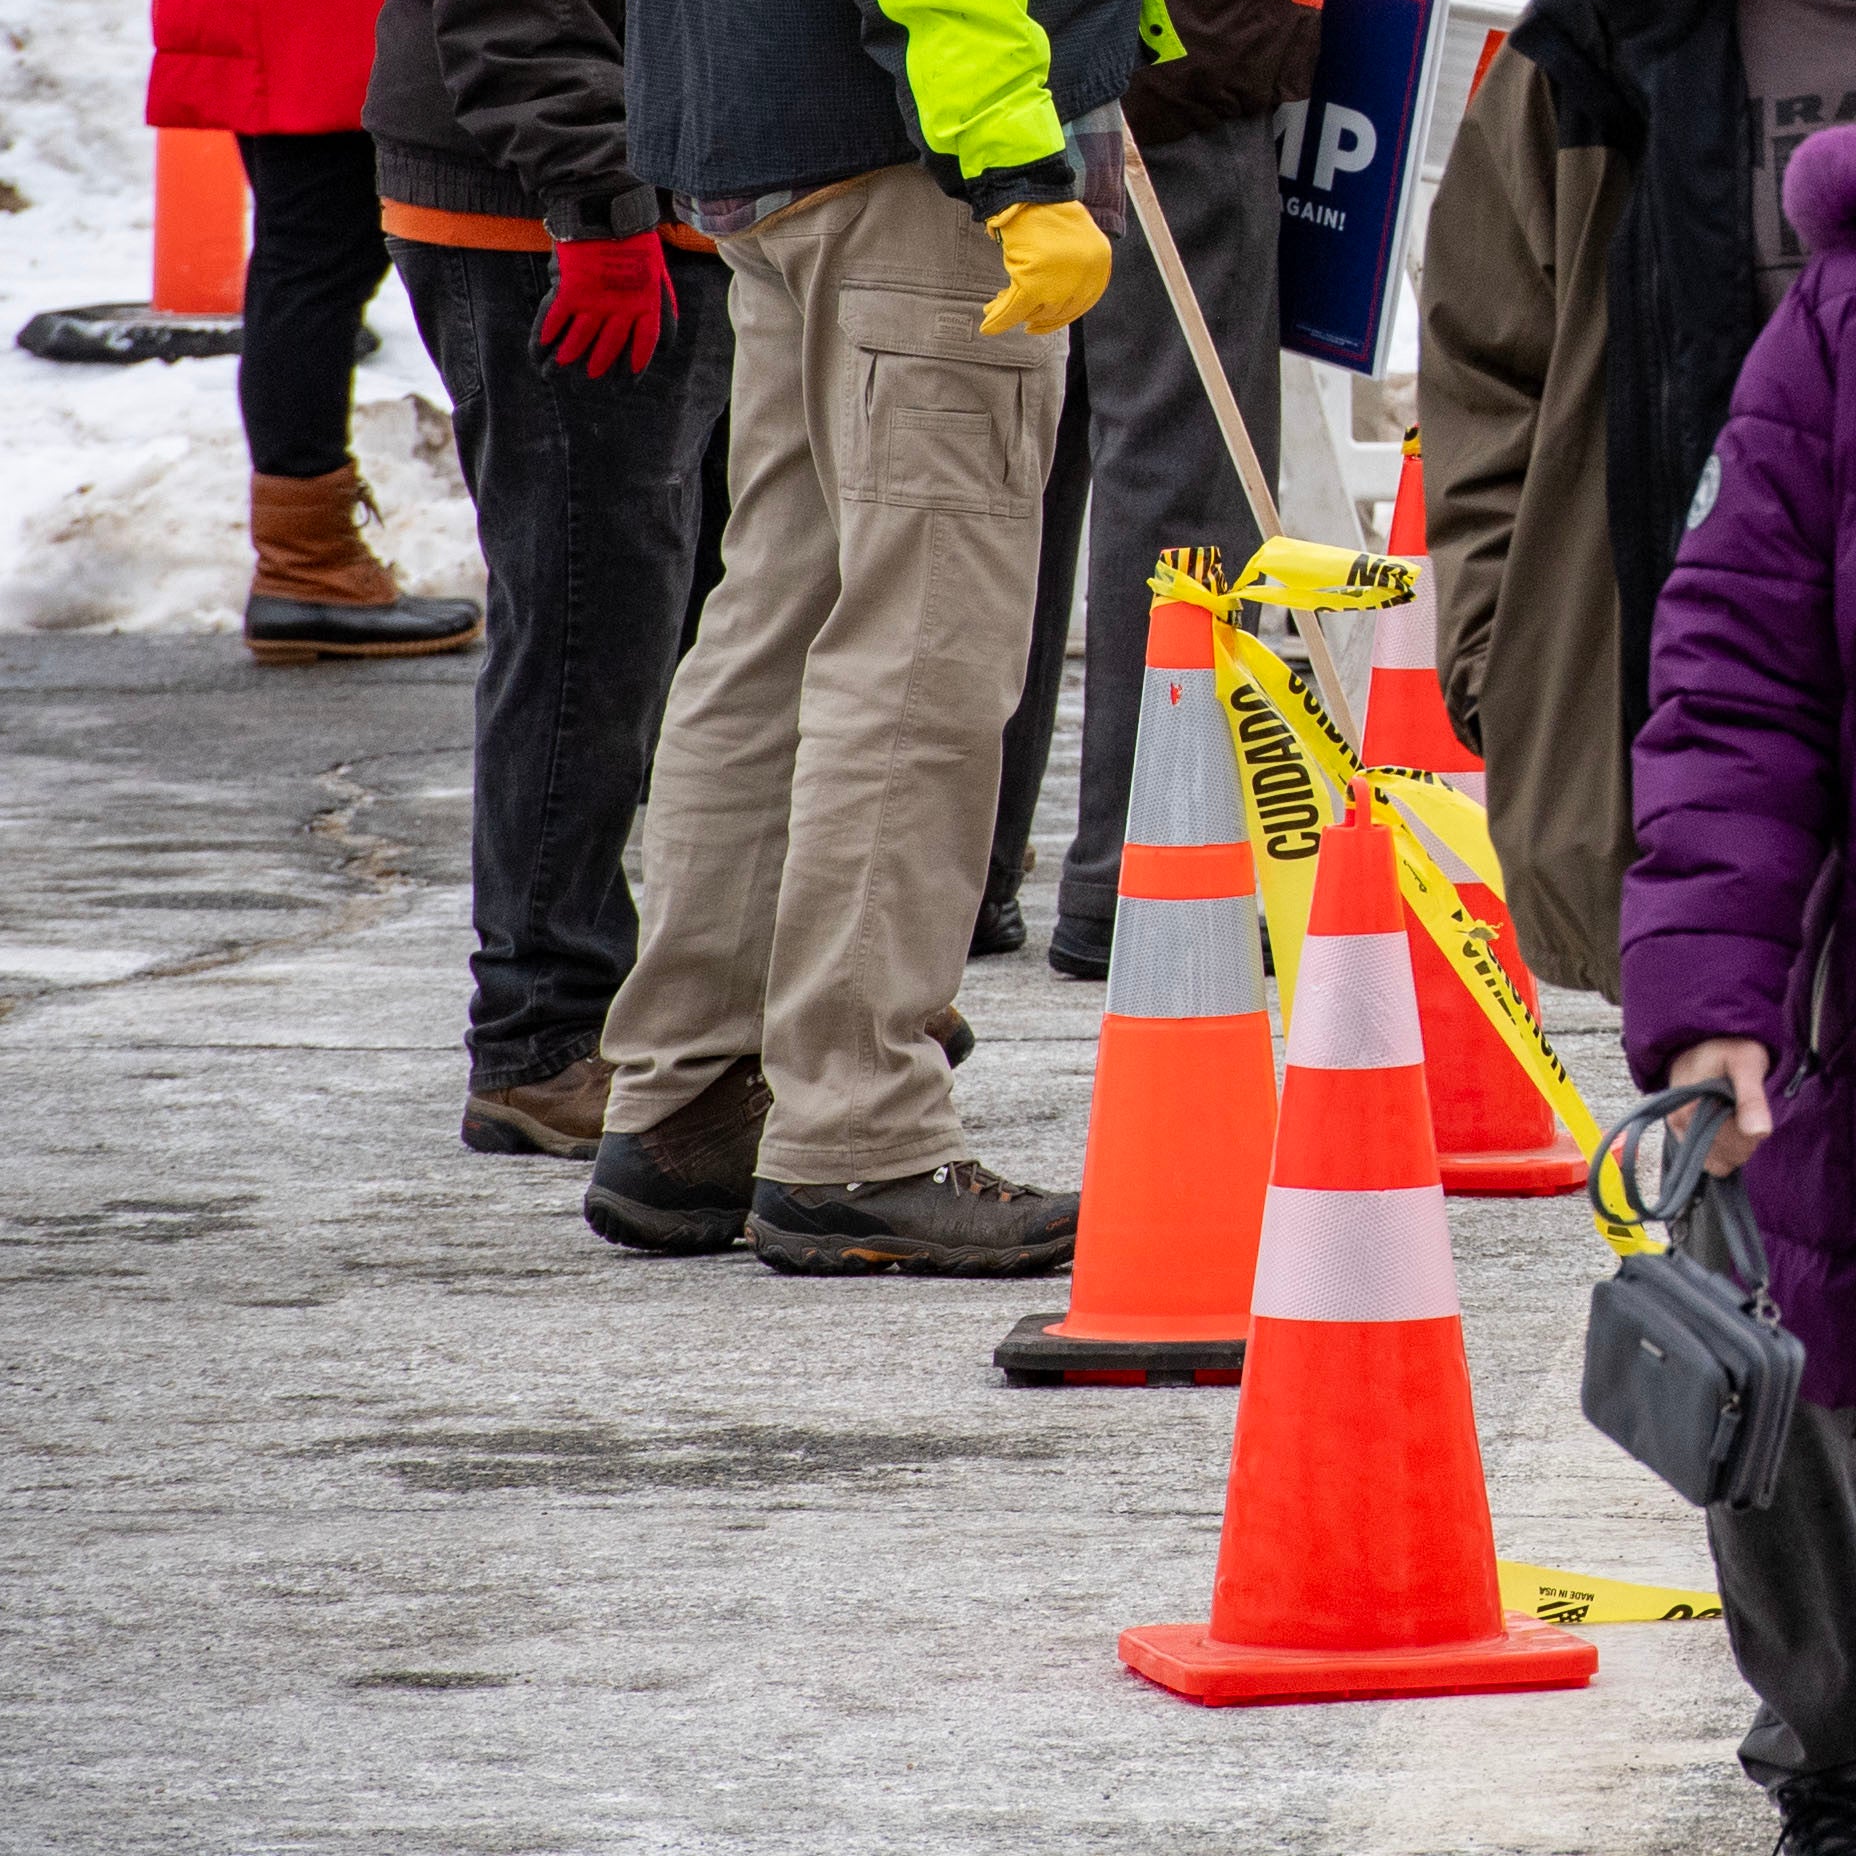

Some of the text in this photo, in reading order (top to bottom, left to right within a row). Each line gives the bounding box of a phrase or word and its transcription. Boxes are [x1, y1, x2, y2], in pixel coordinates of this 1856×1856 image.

[1538, 1585, 1595, 1602] MADE IN USA
